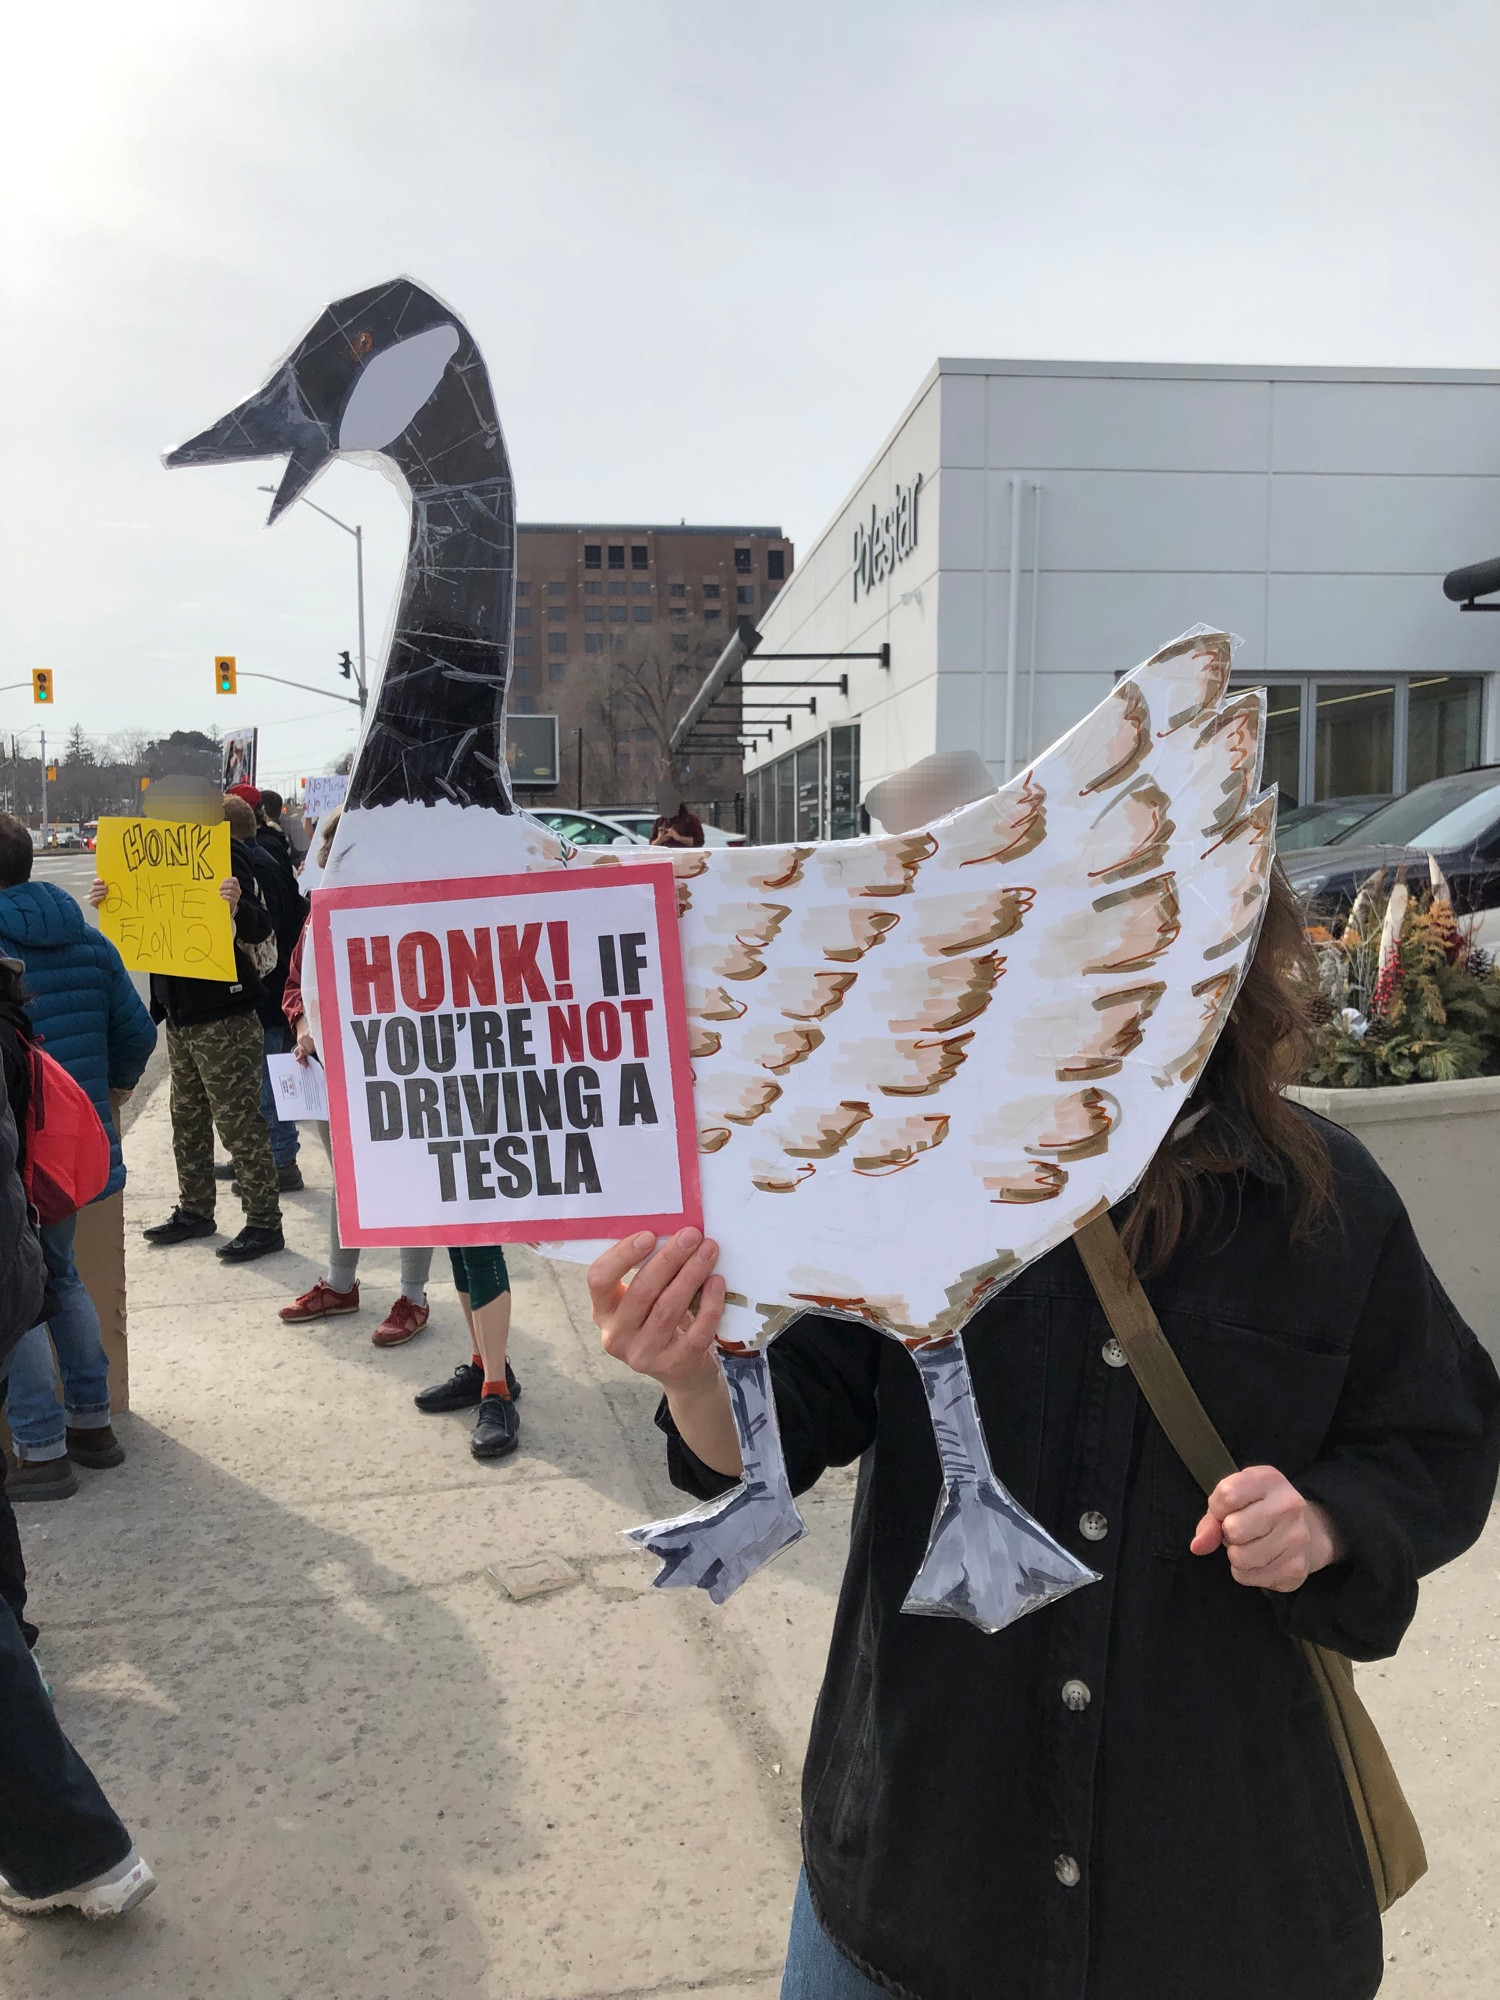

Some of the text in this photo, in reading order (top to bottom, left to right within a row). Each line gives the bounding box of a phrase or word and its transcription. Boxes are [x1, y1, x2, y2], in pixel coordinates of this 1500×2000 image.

[852, 472, 923, 603] Polestar
[307, 794, 344, 813] No Tesl
[308, 779, 321, 794] No
[122, 823, 214, 881] HONK
[105, 874, 209, 920] 2 HATE
[119, 916, 229, 974] ELON 2
[346, 920, 648, 1016] HONK! IF
[350, 998, 654, 1078] YOU'RE NOT
[365, 1065, 604, 1142] DRIVING
[618, 1062, 658, 1126] A
[427, 1131, 603, 1203] TESLA
